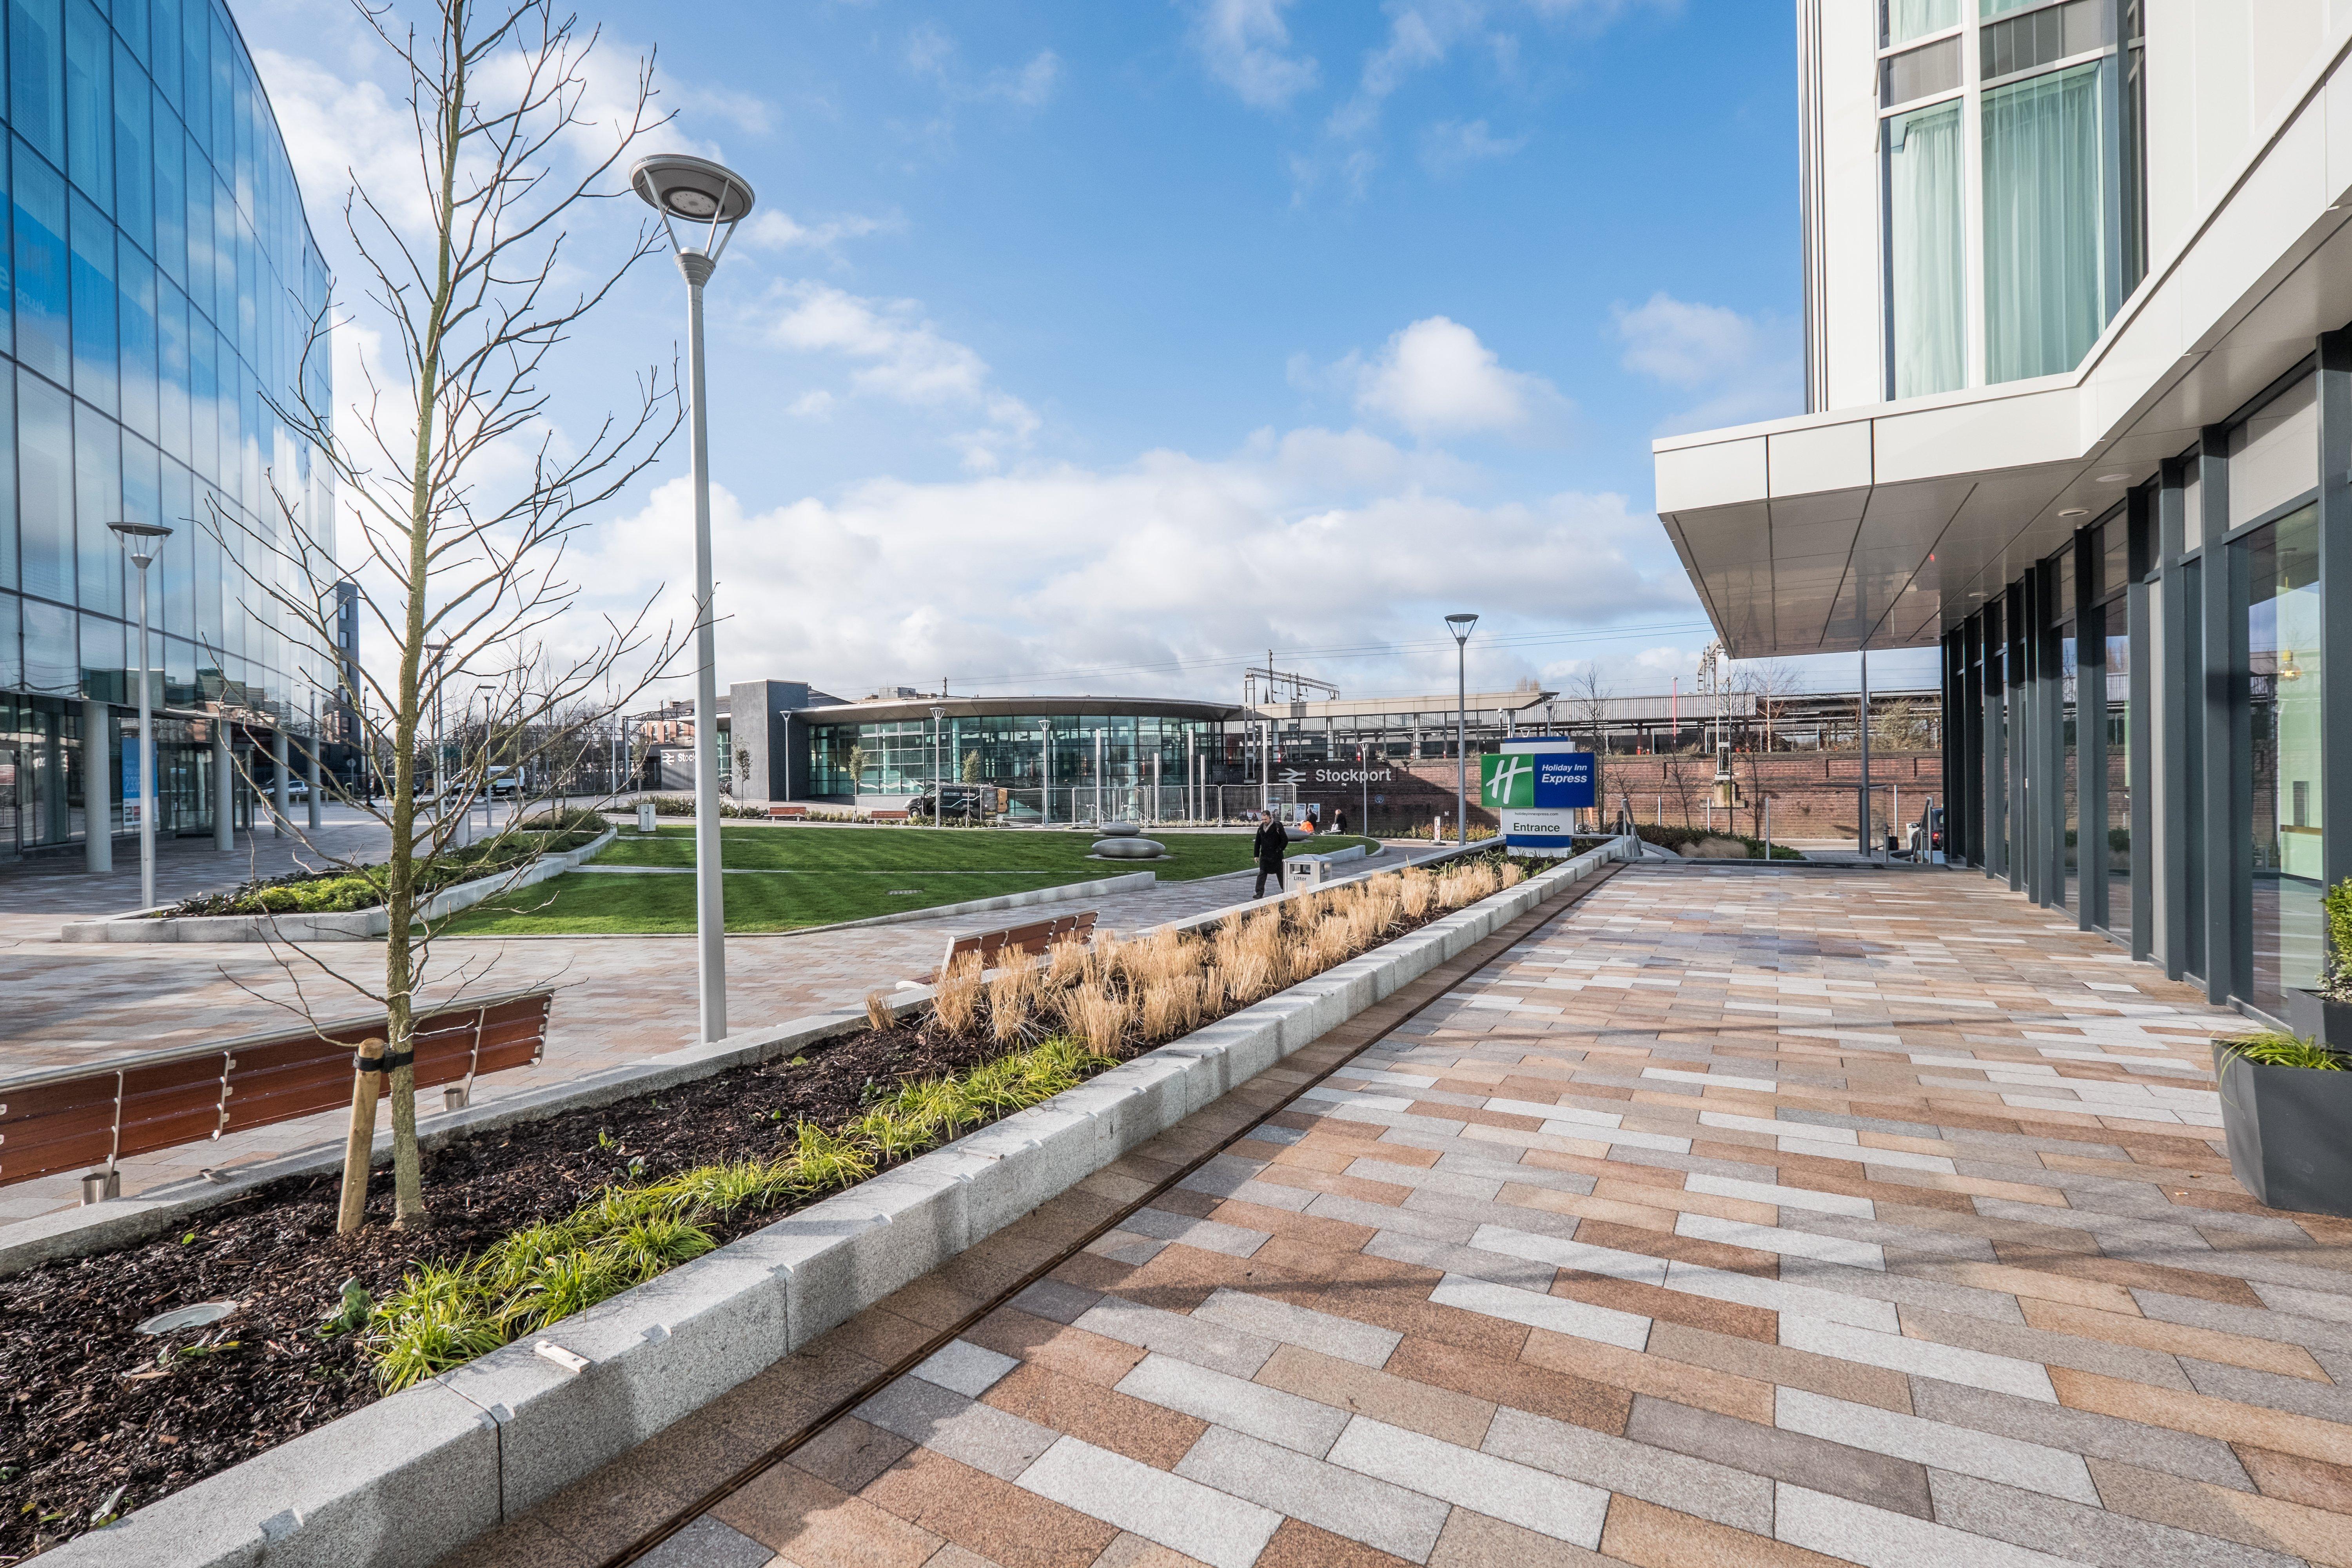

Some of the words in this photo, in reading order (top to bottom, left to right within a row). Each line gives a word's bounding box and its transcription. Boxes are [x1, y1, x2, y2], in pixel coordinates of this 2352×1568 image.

[1542, 764, 1572, 772] Holiday
[1316, 768, 1391, 783] Stockport
[1542, 774, 1587, 785] Express
[1514, 822, 1560, 832] Entrance
